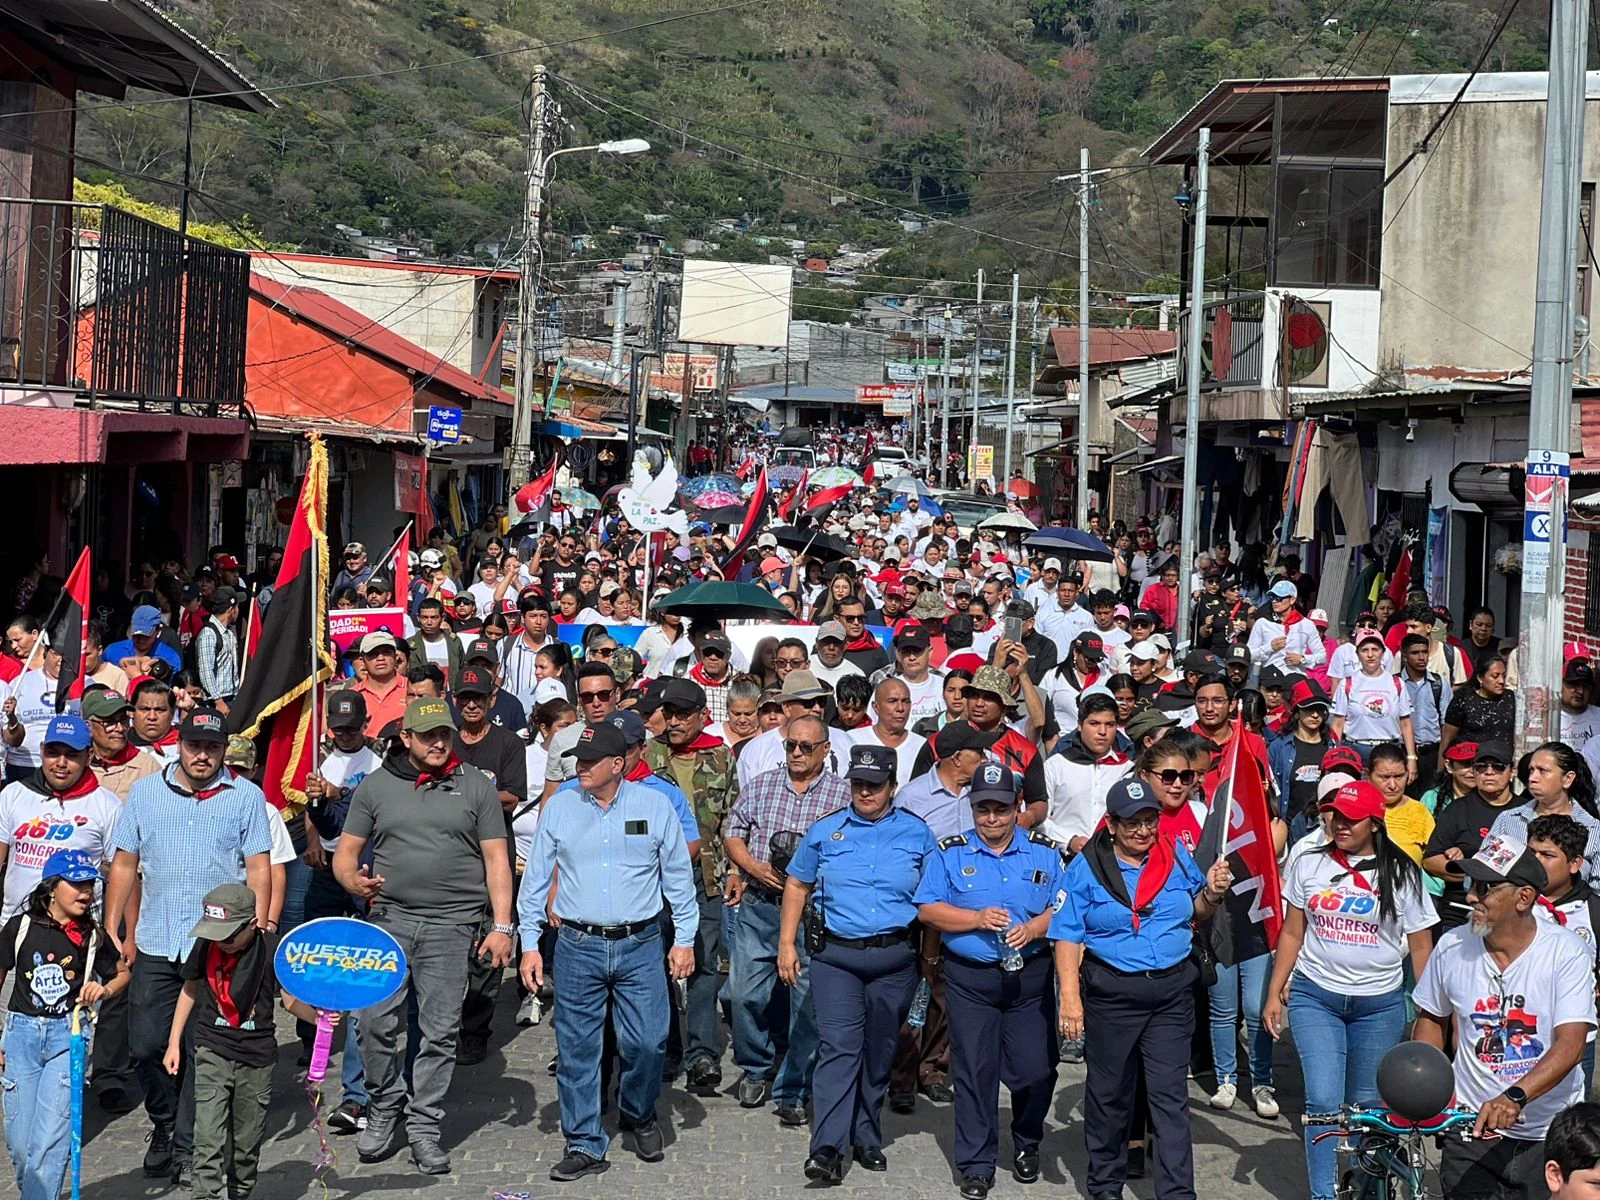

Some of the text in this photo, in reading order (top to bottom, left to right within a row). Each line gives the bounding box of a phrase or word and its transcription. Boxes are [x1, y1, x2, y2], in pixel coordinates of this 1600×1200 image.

[1542, 451, 1551, 462] 9
[1533, 464, 1559, 475] ALN
[1537, 519, 1549, 533] X
[330, 617, 352, 629] DAD
[22, 709, 44, 717] CRUZ
[43, 812, 71, 825] Somos
[13, 820, 74, 841] 4619
[1336, 886, 1372, 898] Somos
[1307, 892, 1375, 915] 4619
[1312, 914, 1379, 935] CONGRESO
[1315, 927, 1378, 945] DEPARTAMENTAL
[285, 942, 399, 962] NUESTRA
[35, 973, 63, 988] Arts
[303, 965, 391, 988] PAZ!
[1480, 1054, 1504, 1063] 2027
